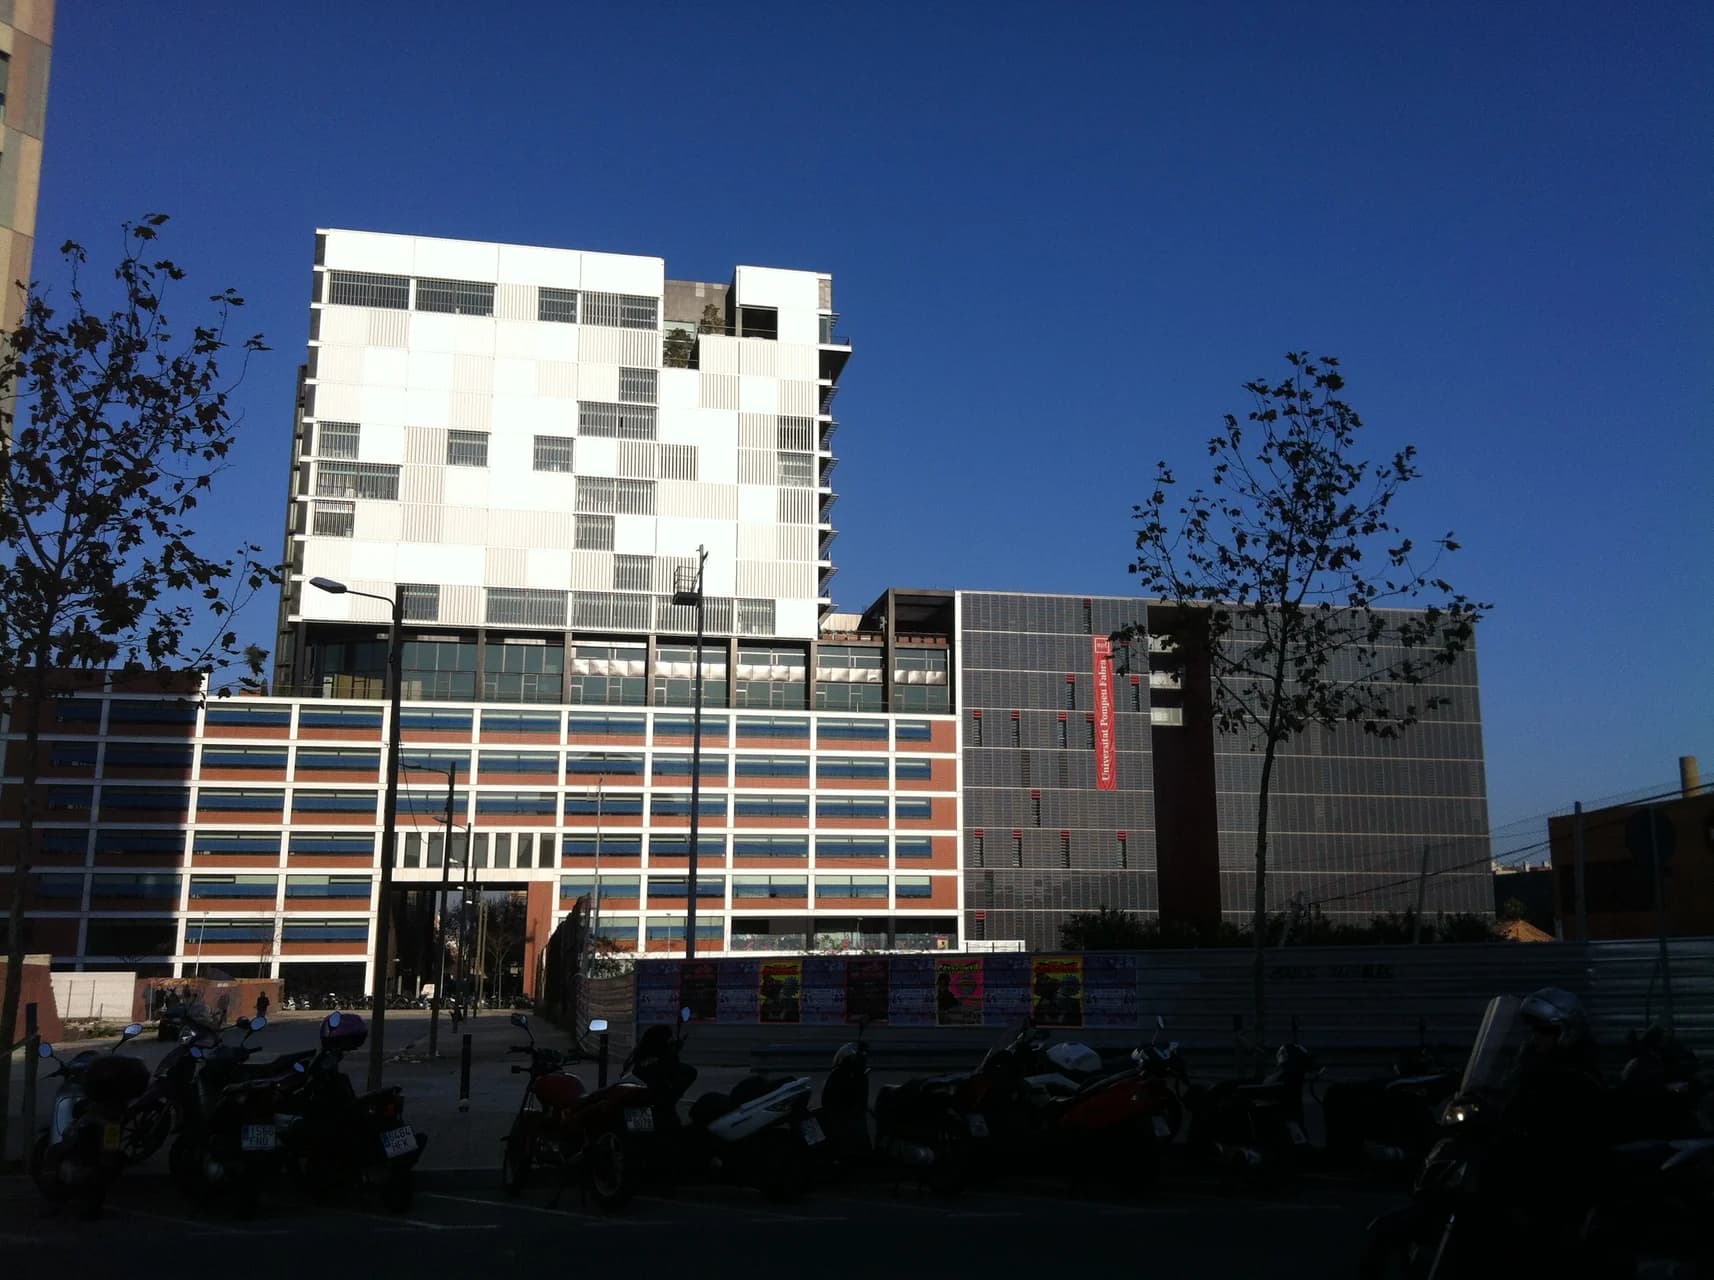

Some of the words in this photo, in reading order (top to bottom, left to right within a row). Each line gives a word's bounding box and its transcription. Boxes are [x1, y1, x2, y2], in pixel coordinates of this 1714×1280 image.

[1098, 659, 1107, 686] Fabra
[1100, 689, 1109, 727] Pompeu
[1101, 729, 1110, 781] Universitat
